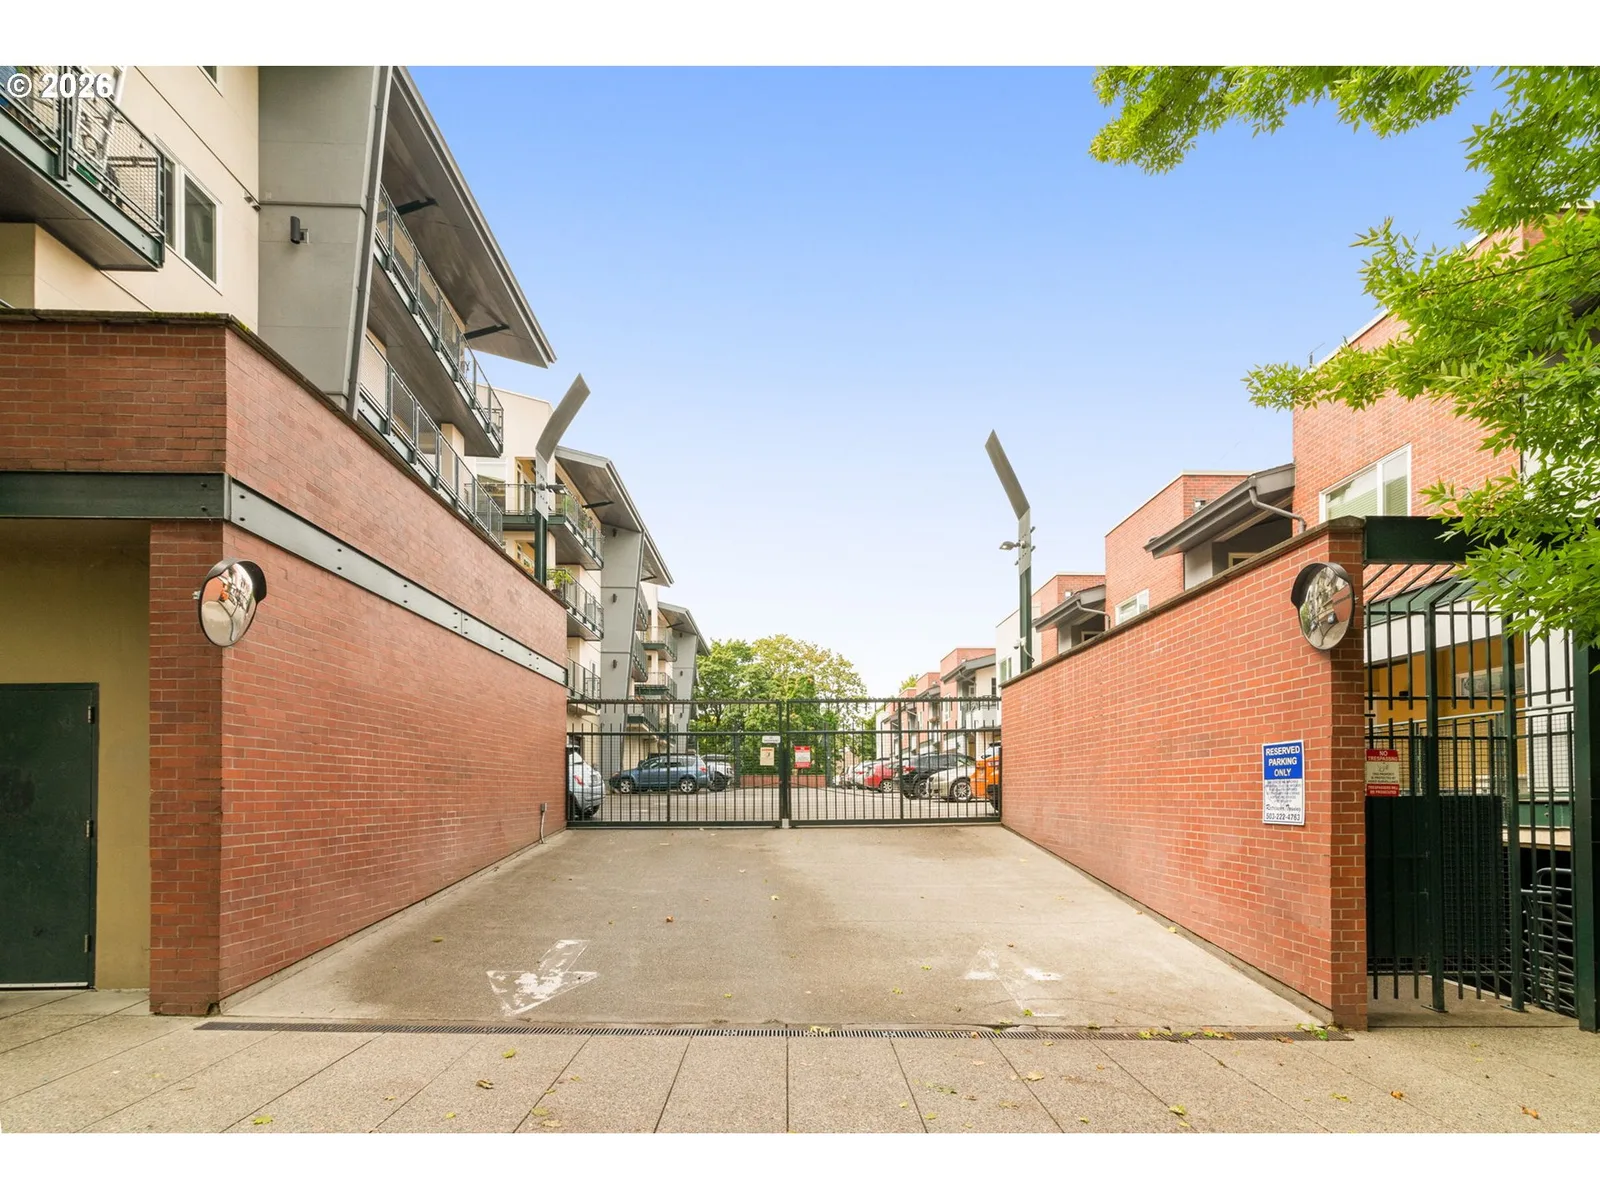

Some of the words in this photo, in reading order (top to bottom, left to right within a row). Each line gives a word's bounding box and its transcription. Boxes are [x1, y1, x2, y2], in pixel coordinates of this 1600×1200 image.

[1266, 745, 1300, 755] RESERVED
[1268, 757, 1297, 767] PARKING
[1274, 768, 1291, 777] ONLY
